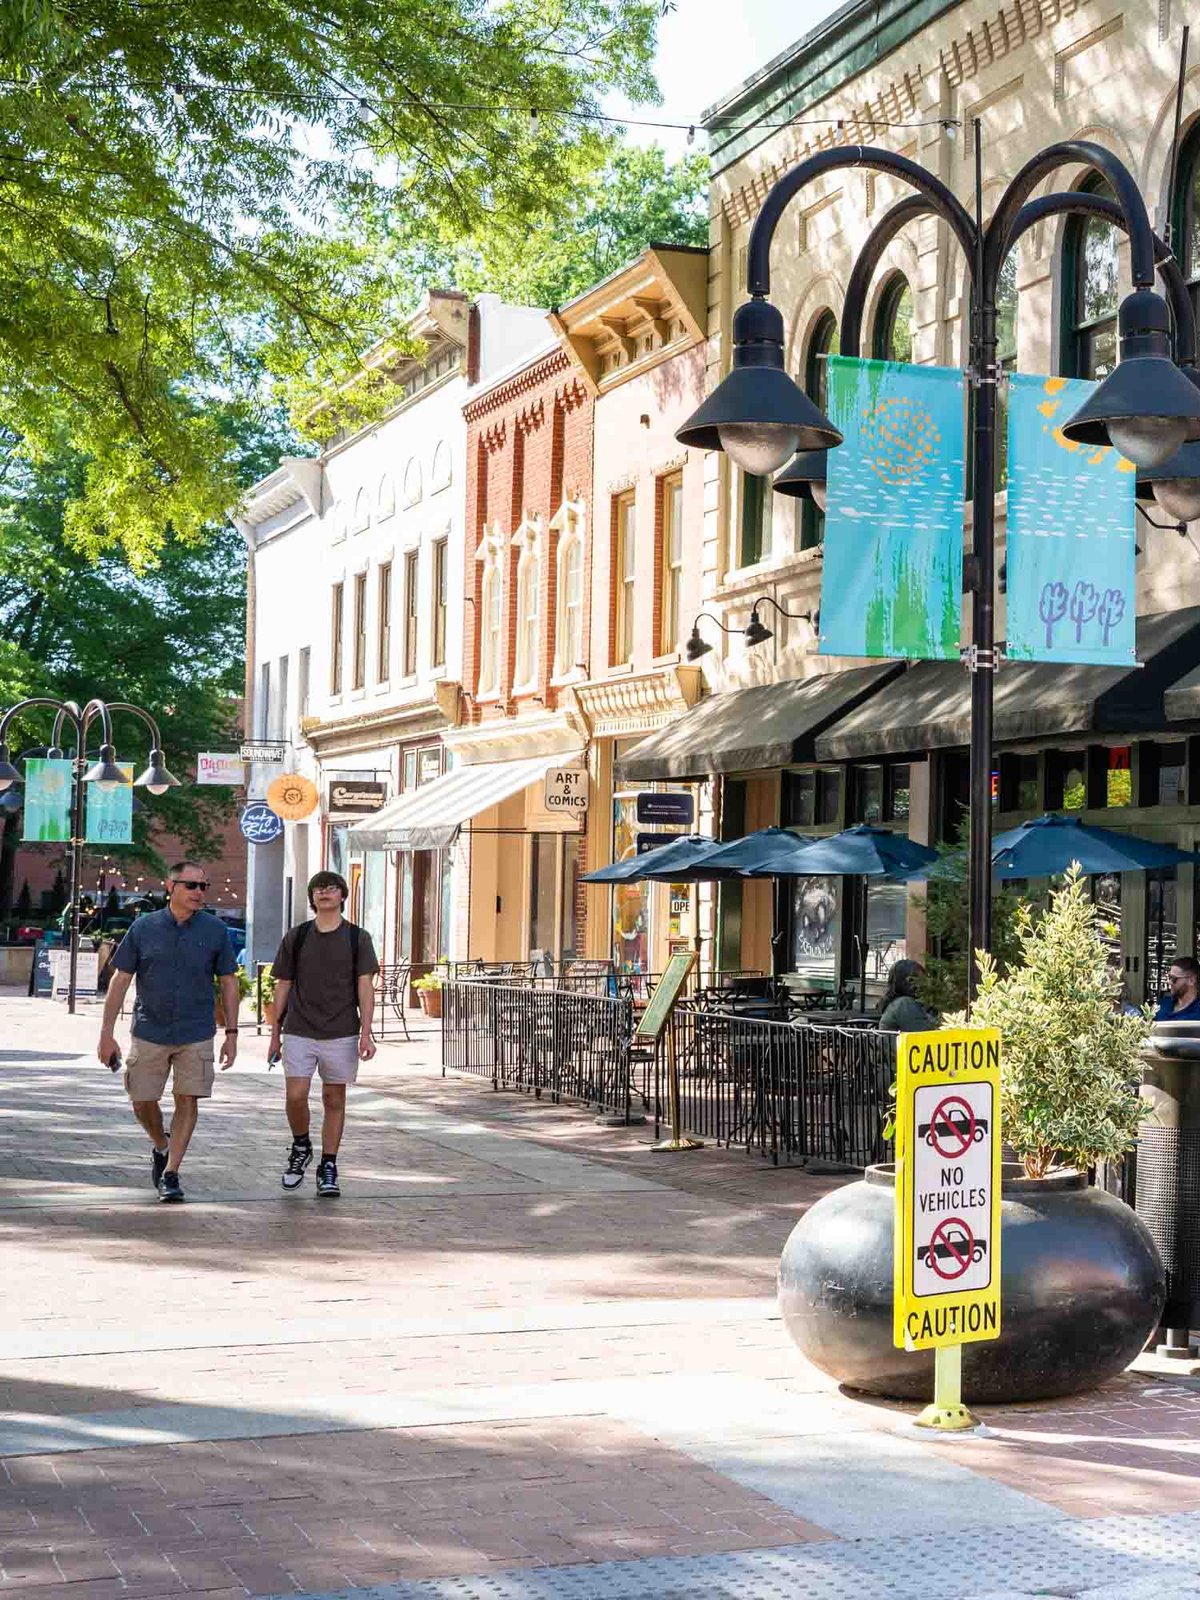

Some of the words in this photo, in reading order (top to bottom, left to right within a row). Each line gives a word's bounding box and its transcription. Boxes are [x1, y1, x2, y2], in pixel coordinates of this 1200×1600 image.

[555, 773, 581, 784] ART
[563, 785, 572, 794] &
[548, 795, 587, 807] COMICS
[241, 804, 276, 828] Lucky
[241, 822, 283, 838] Blue's
[674, 901, 690, 912] OPE
[908, 1040, 999, 1074] CAUTION
[941, 1166, 964, 1186] NO
[919, 1188, 986, 1213] VEHICLES
[907, 1301, 997, 1341] CAUTION
